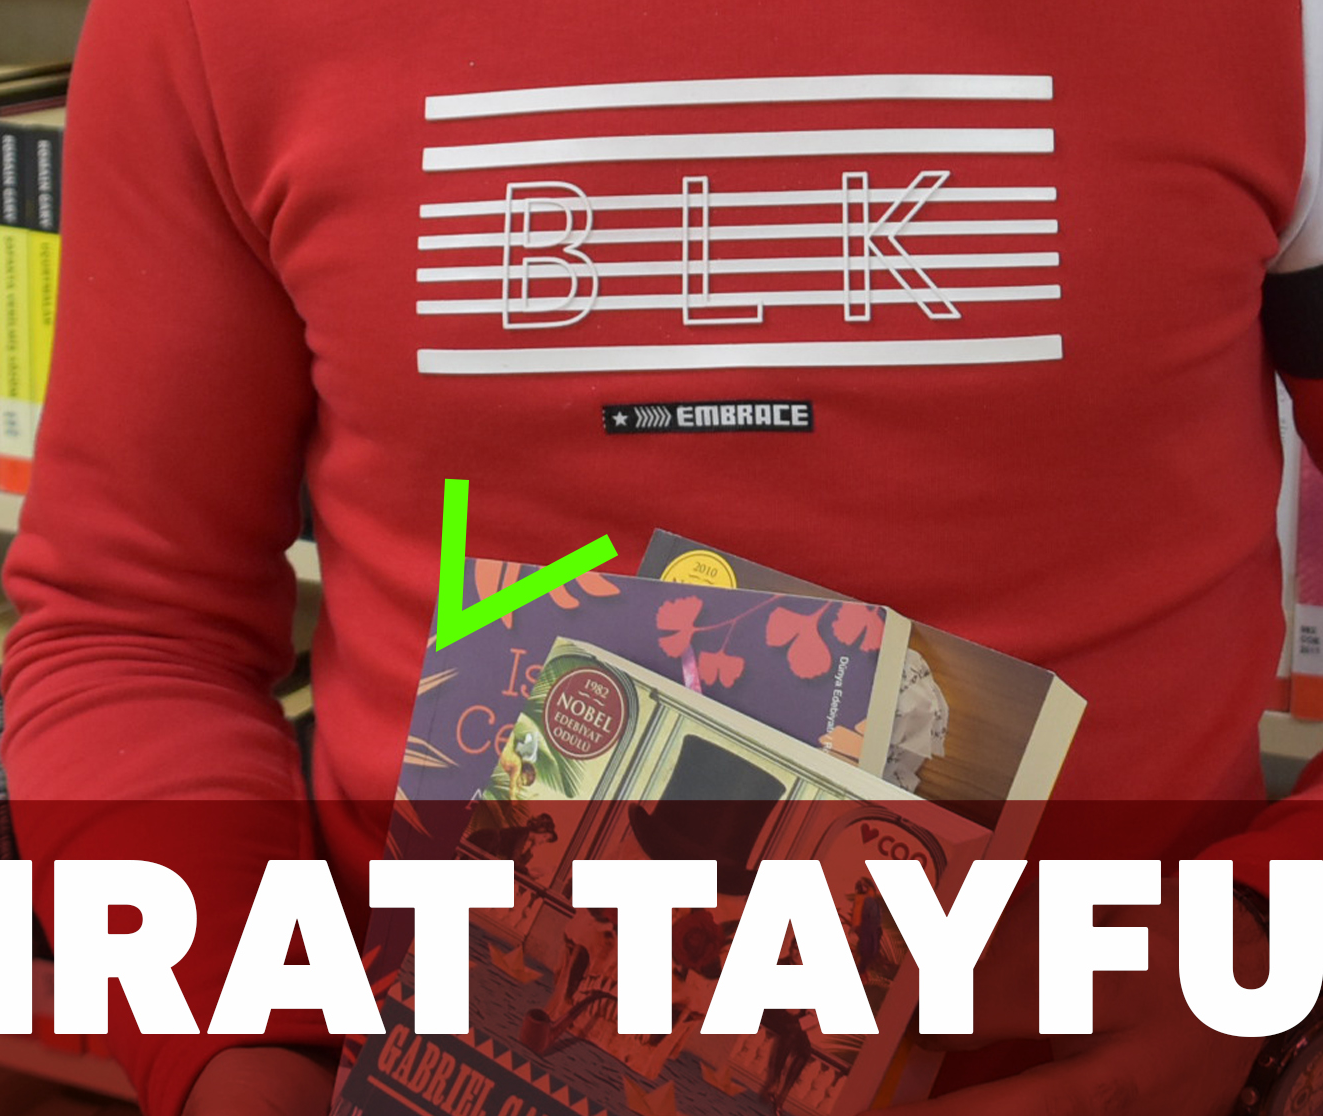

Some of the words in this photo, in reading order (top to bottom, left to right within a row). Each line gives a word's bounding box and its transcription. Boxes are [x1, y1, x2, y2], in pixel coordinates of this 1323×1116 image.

[502, 170, 962, 329] BLK
[676, 403, 810, 428] EMBRACE
[692, 561, 719, 579] 2010
[834, 655, 850, 688] Dünya
[584, 677, 611, 700] 1982
[553, 710, 604, 744] EDEBİYAT
[557, 692, 614, 734] NOBEL
[552, 724, 592, 754] ÖDÜLÜ
[377, 1023, 497, 1116] GABRIEL
